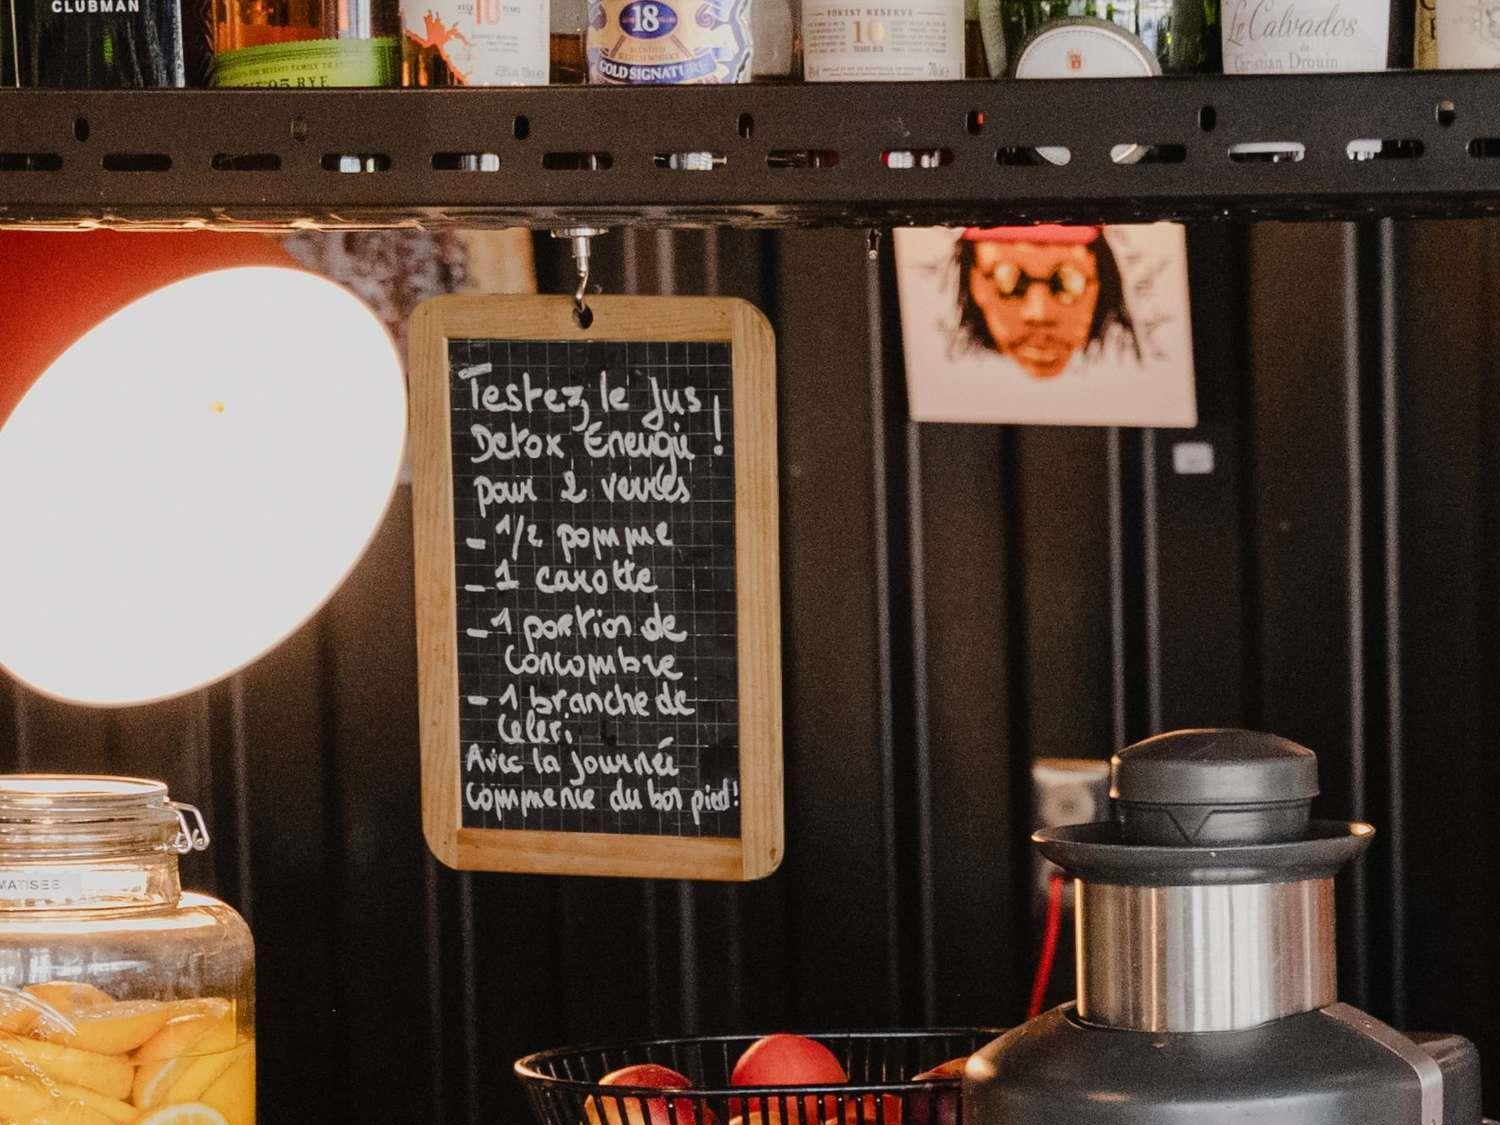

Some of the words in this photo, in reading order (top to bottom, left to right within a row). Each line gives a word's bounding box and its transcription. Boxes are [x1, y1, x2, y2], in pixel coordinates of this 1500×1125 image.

[52, 0, 140, 13] CLUBMAN
[632, 4, 660, 33] 18
[1250, 0, 1359, 41] Calvados
[852, 20, 886, 45] 10
[600, 60, 628, 79] GOLD
[1289, 52, 1339, 70] Drouin
[600, 370, 630, 412] le
[560, 470, 588, 503] 2
[556, 521, 674, 564] pomme
[640, 602, 688, 642] de
[529, 683, 650, 717] branche
[655, 681, 696, 716] de
[532, 747, 562, 773] la
[609, 778, 644, 812] du
[647, 778, 683, 811] bon
